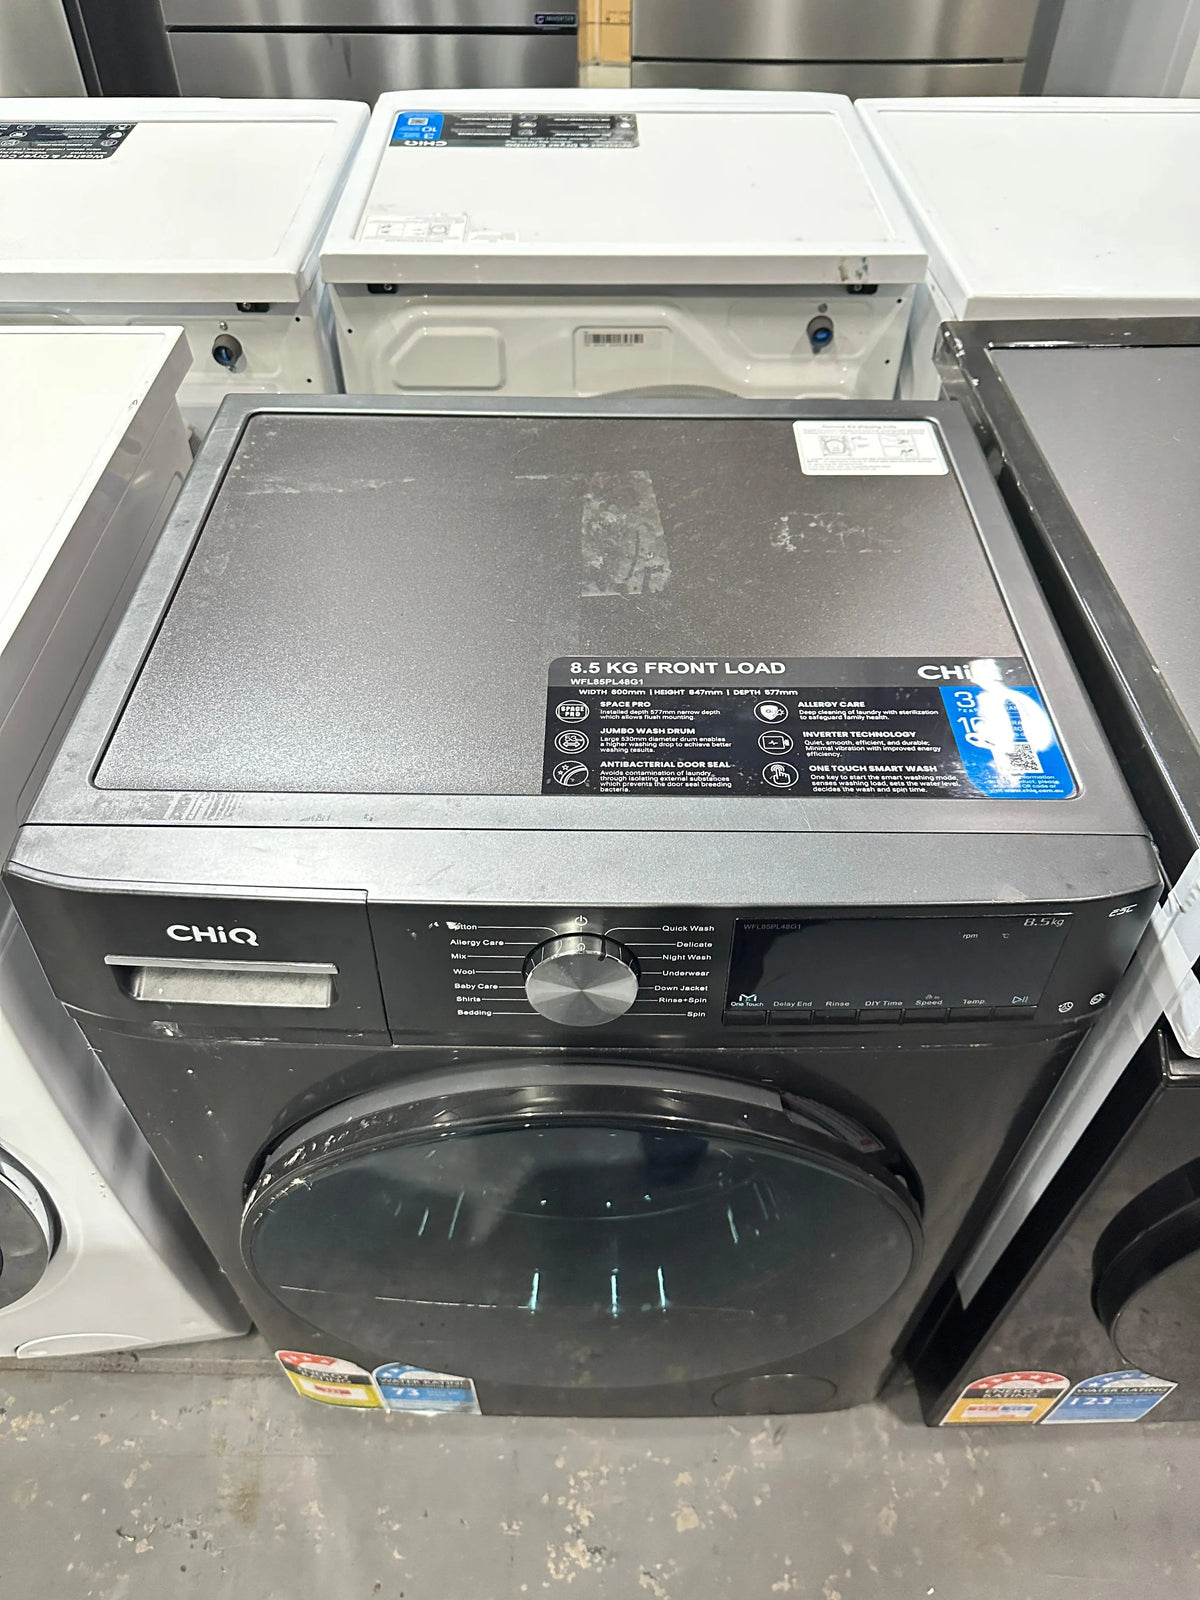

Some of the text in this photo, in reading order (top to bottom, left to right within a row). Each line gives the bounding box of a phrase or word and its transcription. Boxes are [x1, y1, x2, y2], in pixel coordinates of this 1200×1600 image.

[570, 662, 786, 674] 8.5 KG FRONT LOAD
[954, 691, 976, 708] 3
[701, 781, 732, 789] breeding
[838, 780, 869, 788] washing
[166, 924, 260, 946] CHiQ
[457, 1009, 492, 1017] Bedding
[392, 1387, 420, 1396] 73
